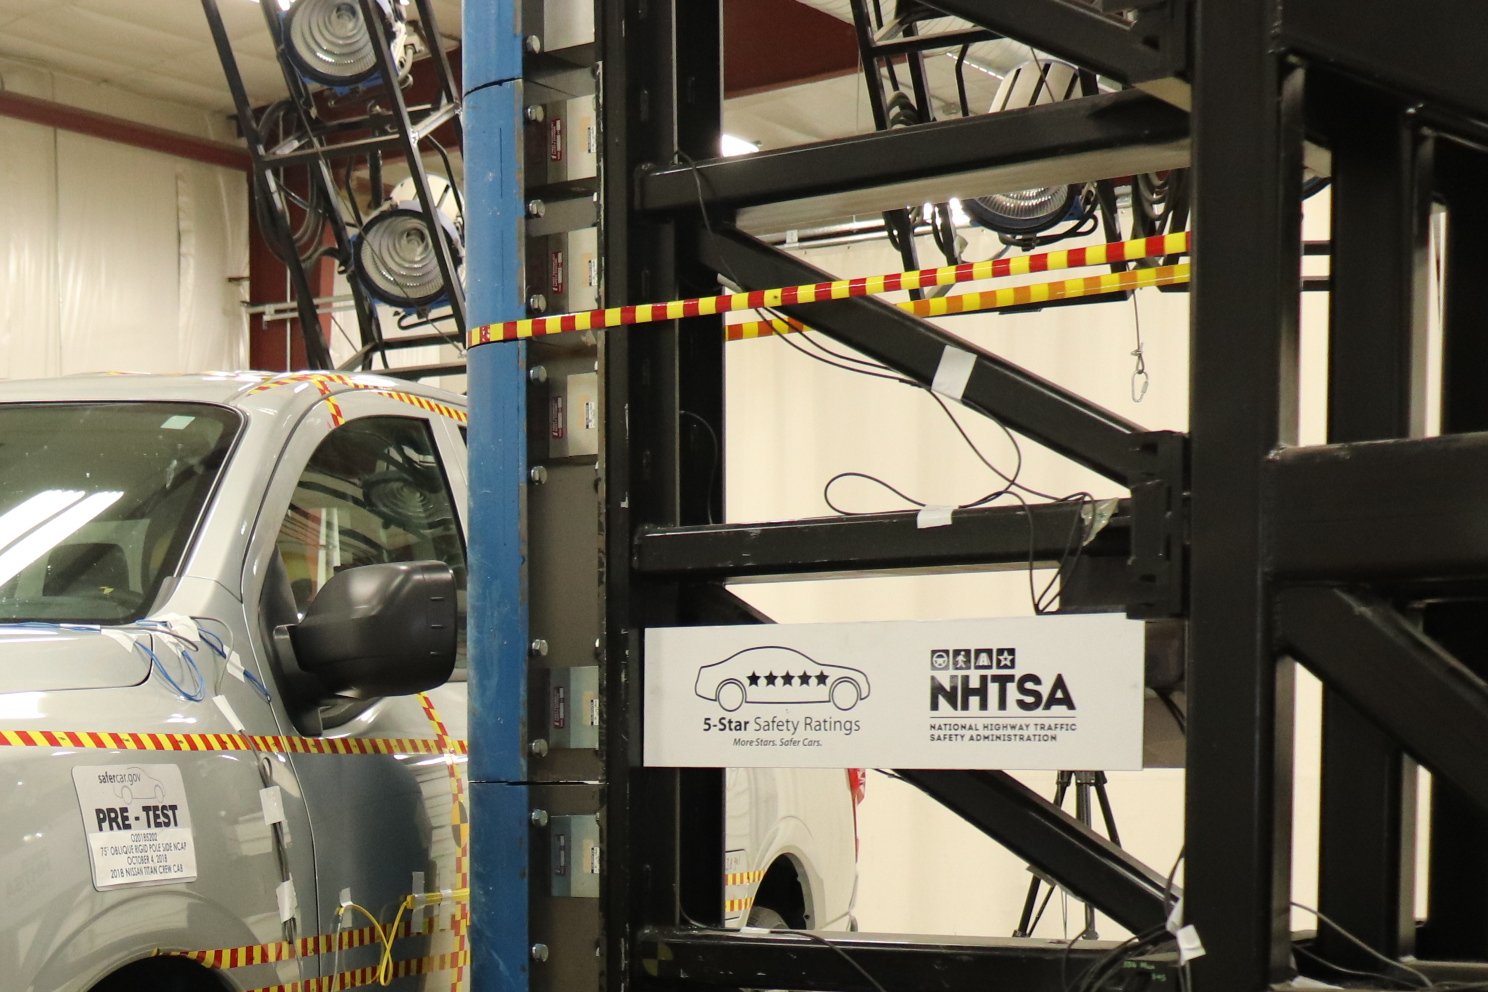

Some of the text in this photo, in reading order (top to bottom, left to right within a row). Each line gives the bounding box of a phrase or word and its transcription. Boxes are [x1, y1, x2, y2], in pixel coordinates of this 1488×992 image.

[930, 673, 1076, 711] NHTSA
[703, 716, 860, 736] 5-Star Safety Ratings
[930, 723, 1077, 731] NATIONAL HIGHWAY TRAFFIC
[733, 738, 823, 747] More Stars. Safer Cars.
[930, 734, 1057, 742] SAFETY ADMINISTRATION
[98, 771, 141, 785] safercar.gov
[95, 807, 132, 832] PRE
[142, 804, 178, 829] TEST
[110, 845, 134, 856] OBLIQUE
[134, 844, 148, 854] RIGID
[149, 843, 161, 853] POLE
[161, 842, 172, 852] SIDE
[173, 841, 187, 851] NCAP
[127, 855, 150, 866] OCTOBER
[156, 854, 168, 864] 2018
[110, 863, 184, 879] 2018 NISSAN TITAN CREW CAB
